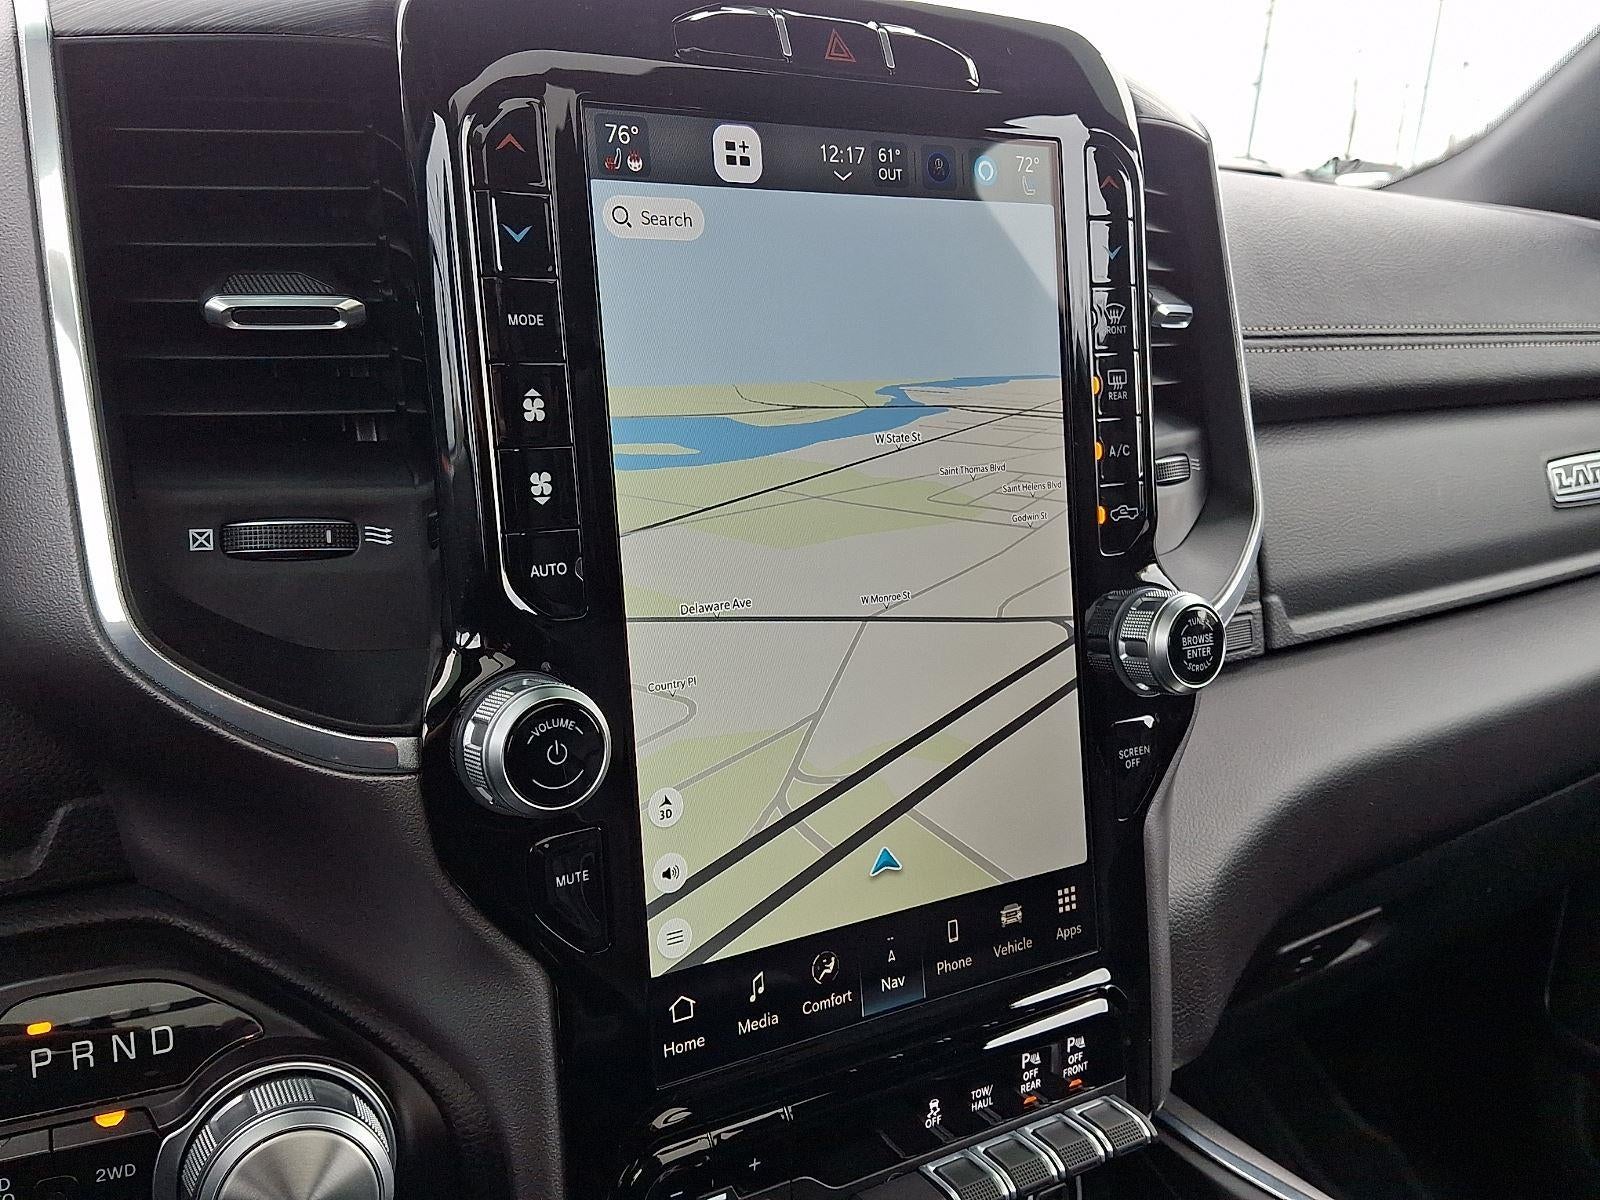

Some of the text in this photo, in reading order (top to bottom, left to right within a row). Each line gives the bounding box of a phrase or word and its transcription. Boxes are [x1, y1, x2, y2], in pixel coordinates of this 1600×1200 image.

[604, 124, 639, 145] 76°
[820, 144, 865, 166] 12:17
[878, 147, 900, 164] 61°
[1015, 155, 1040, 174] 72°
[878, 167, 902, 182] OUT
[641, 210, 694, 229] Search
[508, 313, 544, 327] MODE
[1108, 391, 1128, 401] REAR
[875, 431, 921, 444] W State St
[1109, 444, 1130, 457] A/C
[939, 463, 1006, 476] Saint Thomas Blvd
[1002, 480, 1062, 493] Saint Helens Blvd
[1012, 511, 1048, 523] Godwin St
[530, 562, 568, 578] AUTO
[861, 591, 911, 605] W Monroe St
[680, 598, 752, 615] Delaware Ave
[1182, 633, 1214, 646] BROWSE
[1187, 647, 1212, 659] ENTER
[1187, 660, 1211, 672] SCROLL
[648, 681, 685, 694] Country
[531, 718, 576, 737] VOLUME
[1118, 745, 1150, 759] SCREEN
[1125, 757, 1141, 769] OFF
[660, 808, 672, 820] 3D
[555, 870, 590, 888] MUTE
[1056, 924, 1082, 941] Apps
[993, 937, 1033, 958] Vehicle
[936, 955, 973, 976] Phone
[881, 974, 906, 993] Nav
[802, 990, 853, 1017] Comfort
[737, 1012, 779, 1036] Media
[30, 1025, 174, 1078] P R N D
[662, 1034, 706, 1058] Home
[1068, 1051, 1084, 1065] OFF
[1023, 1068, 1039, 1081] OFF
[1063, 1062, 1088, 1078] FRONT
[971, 1084, 994, 1100] TOW/
[1020, 1079, 1041, 1094] REAR
[971, 1097, 994, 1112] HAUL
[925, 1115, 942, 1129] OFF
[96, 1163, 137, 1183] 2WD
